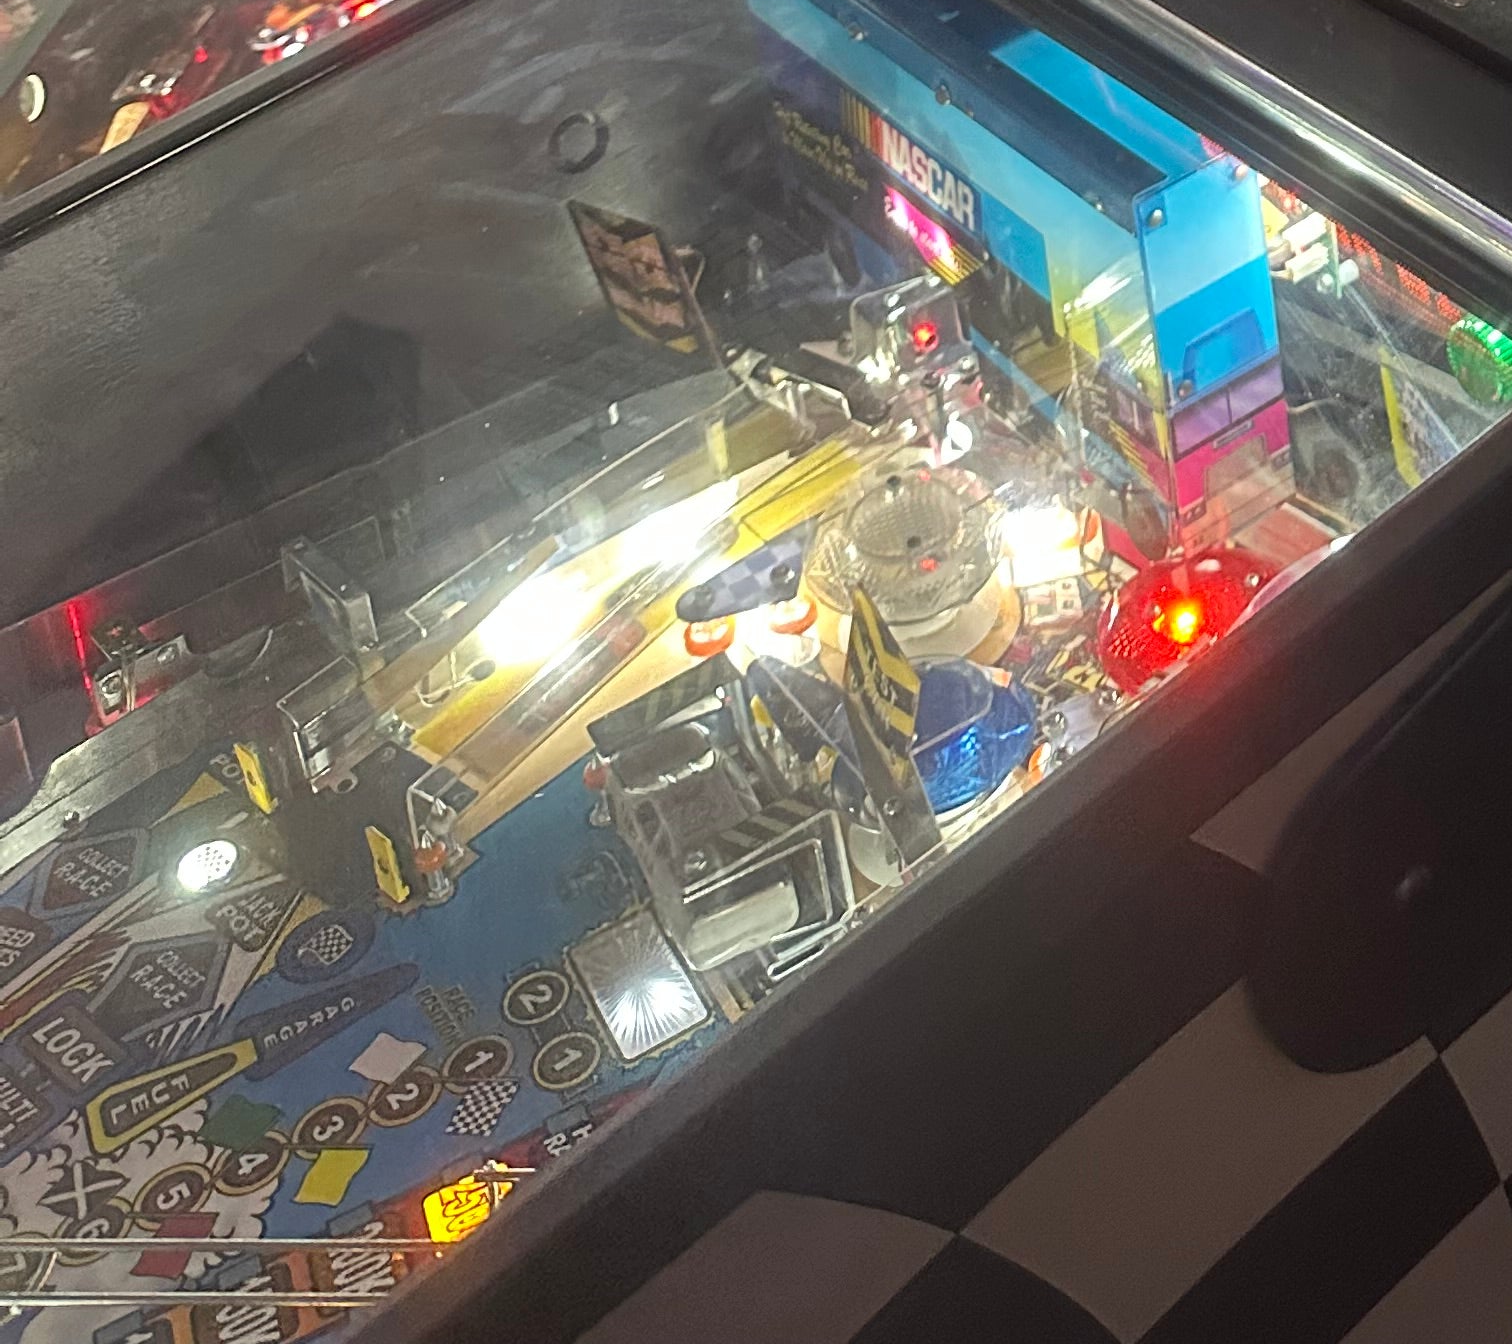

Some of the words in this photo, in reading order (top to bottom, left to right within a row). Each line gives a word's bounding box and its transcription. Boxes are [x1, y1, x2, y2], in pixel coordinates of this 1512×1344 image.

[882, 119, 975, 232] NASCAR
[78, 847, 131, 879] COLLECT
[215, 904, 265, 949] POT
[157, 949, 207, 988] COLLECT
[519, 983, 553, 1014] 2
[262, 996, 356, 1049] GARAGE
[31, 1016, 115, 1084] LOCK
[464, 1049, 495, 1074] 1
[552, 1047, 583, 1073] 1
[109, 1074, 191, 1126] FUEL
[385, 1083, 420, 1111] 2
[312, 1114, 345, 1143] 3
[237, 1153, 269, 1177] 4
[156, 1181, 193, 1210] 5
